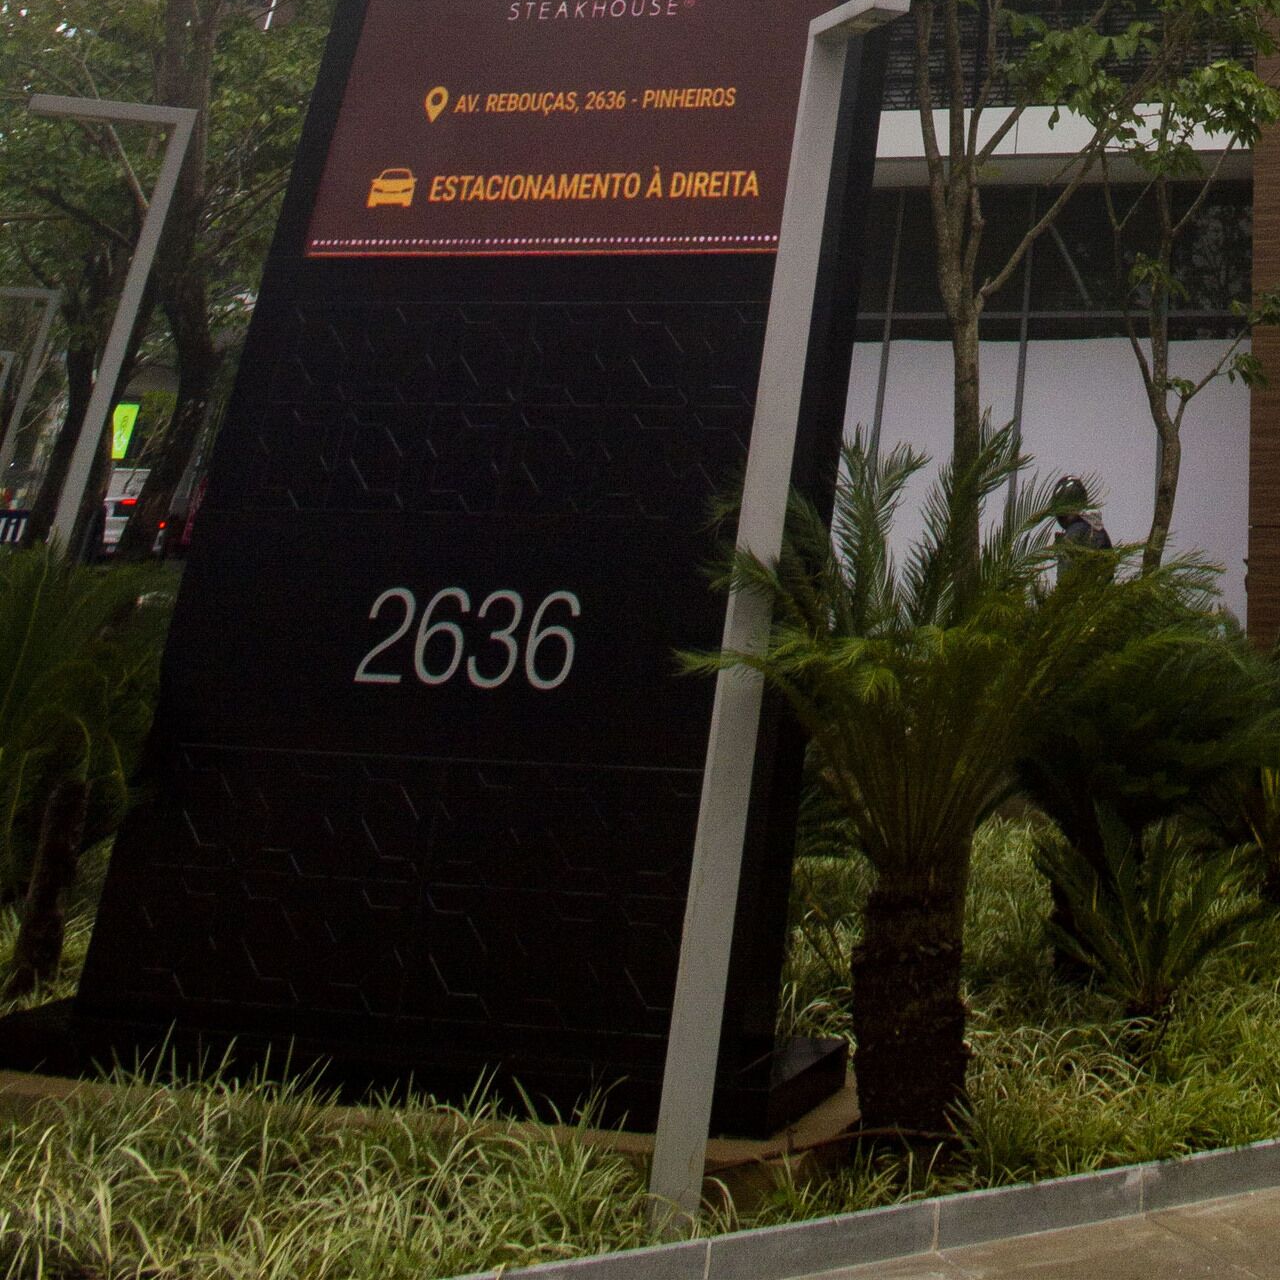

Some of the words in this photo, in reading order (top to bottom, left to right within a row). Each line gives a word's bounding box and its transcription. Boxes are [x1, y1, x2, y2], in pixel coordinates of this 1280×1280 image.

[454, 95, 480, 113] AV.
[485, 93, 580, 116] REBOUÇAS,
[585, 91, 627, 110] 2636
[642, 88, 737, 108] PINHEIROS
[428, 172, 639, 201] ESTACIONAMENTO
[646, 165, 663, 197] À
[669, 170, 760, 197] DIREITA
[353, 586, 582, 690] 2636
